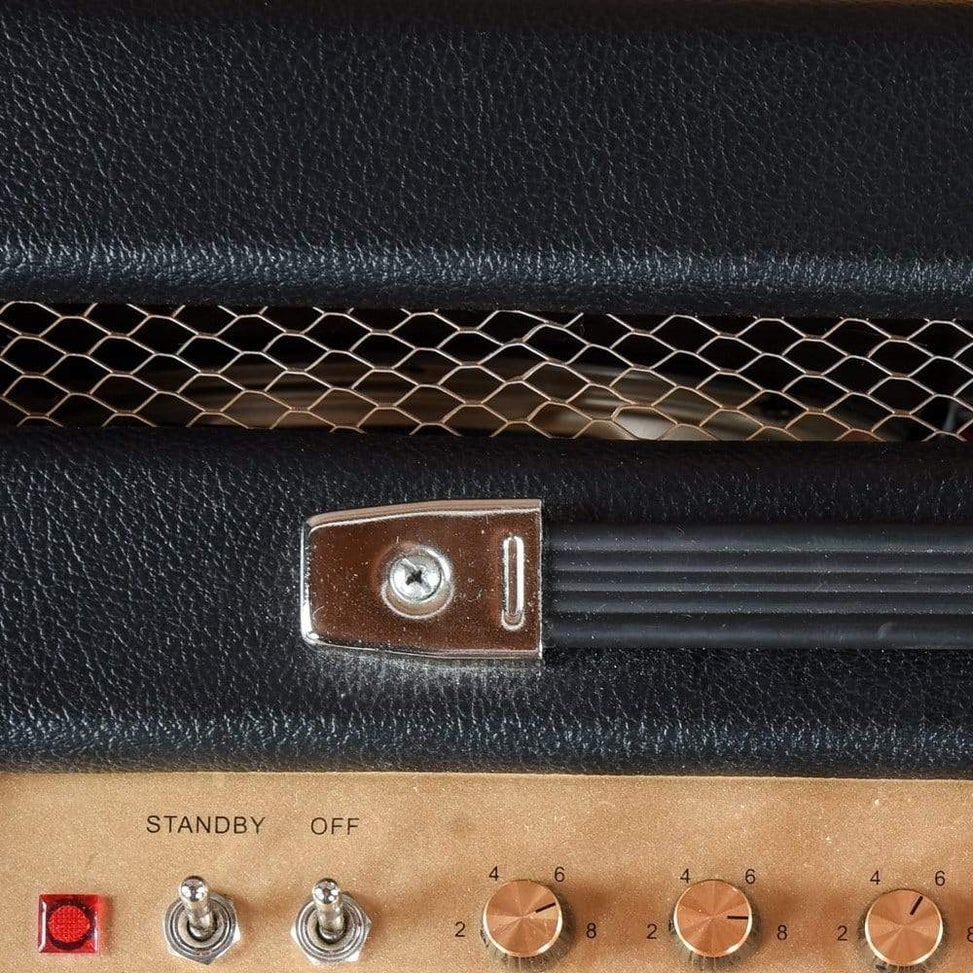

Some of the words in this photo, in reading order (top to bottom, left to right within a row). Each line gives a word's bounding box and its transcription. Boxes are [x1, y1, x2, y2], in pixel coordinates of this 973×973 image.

[147, 815, 266, 835] STANDBY
[310, 817, 360, 835] OFF
[488, 865, 500, 882] 4
[553, 866, 566, 883] 6
[679, 868, 691, 885] 4
[744, 869, 757, 886] 6
[869, 870, 881, 886] 4
[934, 870, 946, 887] 6
[454, 920, 466, 938] 2
[585, 922, 597, 940] 8
[645, 923, 658, 940] 2
[776, 925, 788, 942] 8
[836, 924, 848, 942] 2
